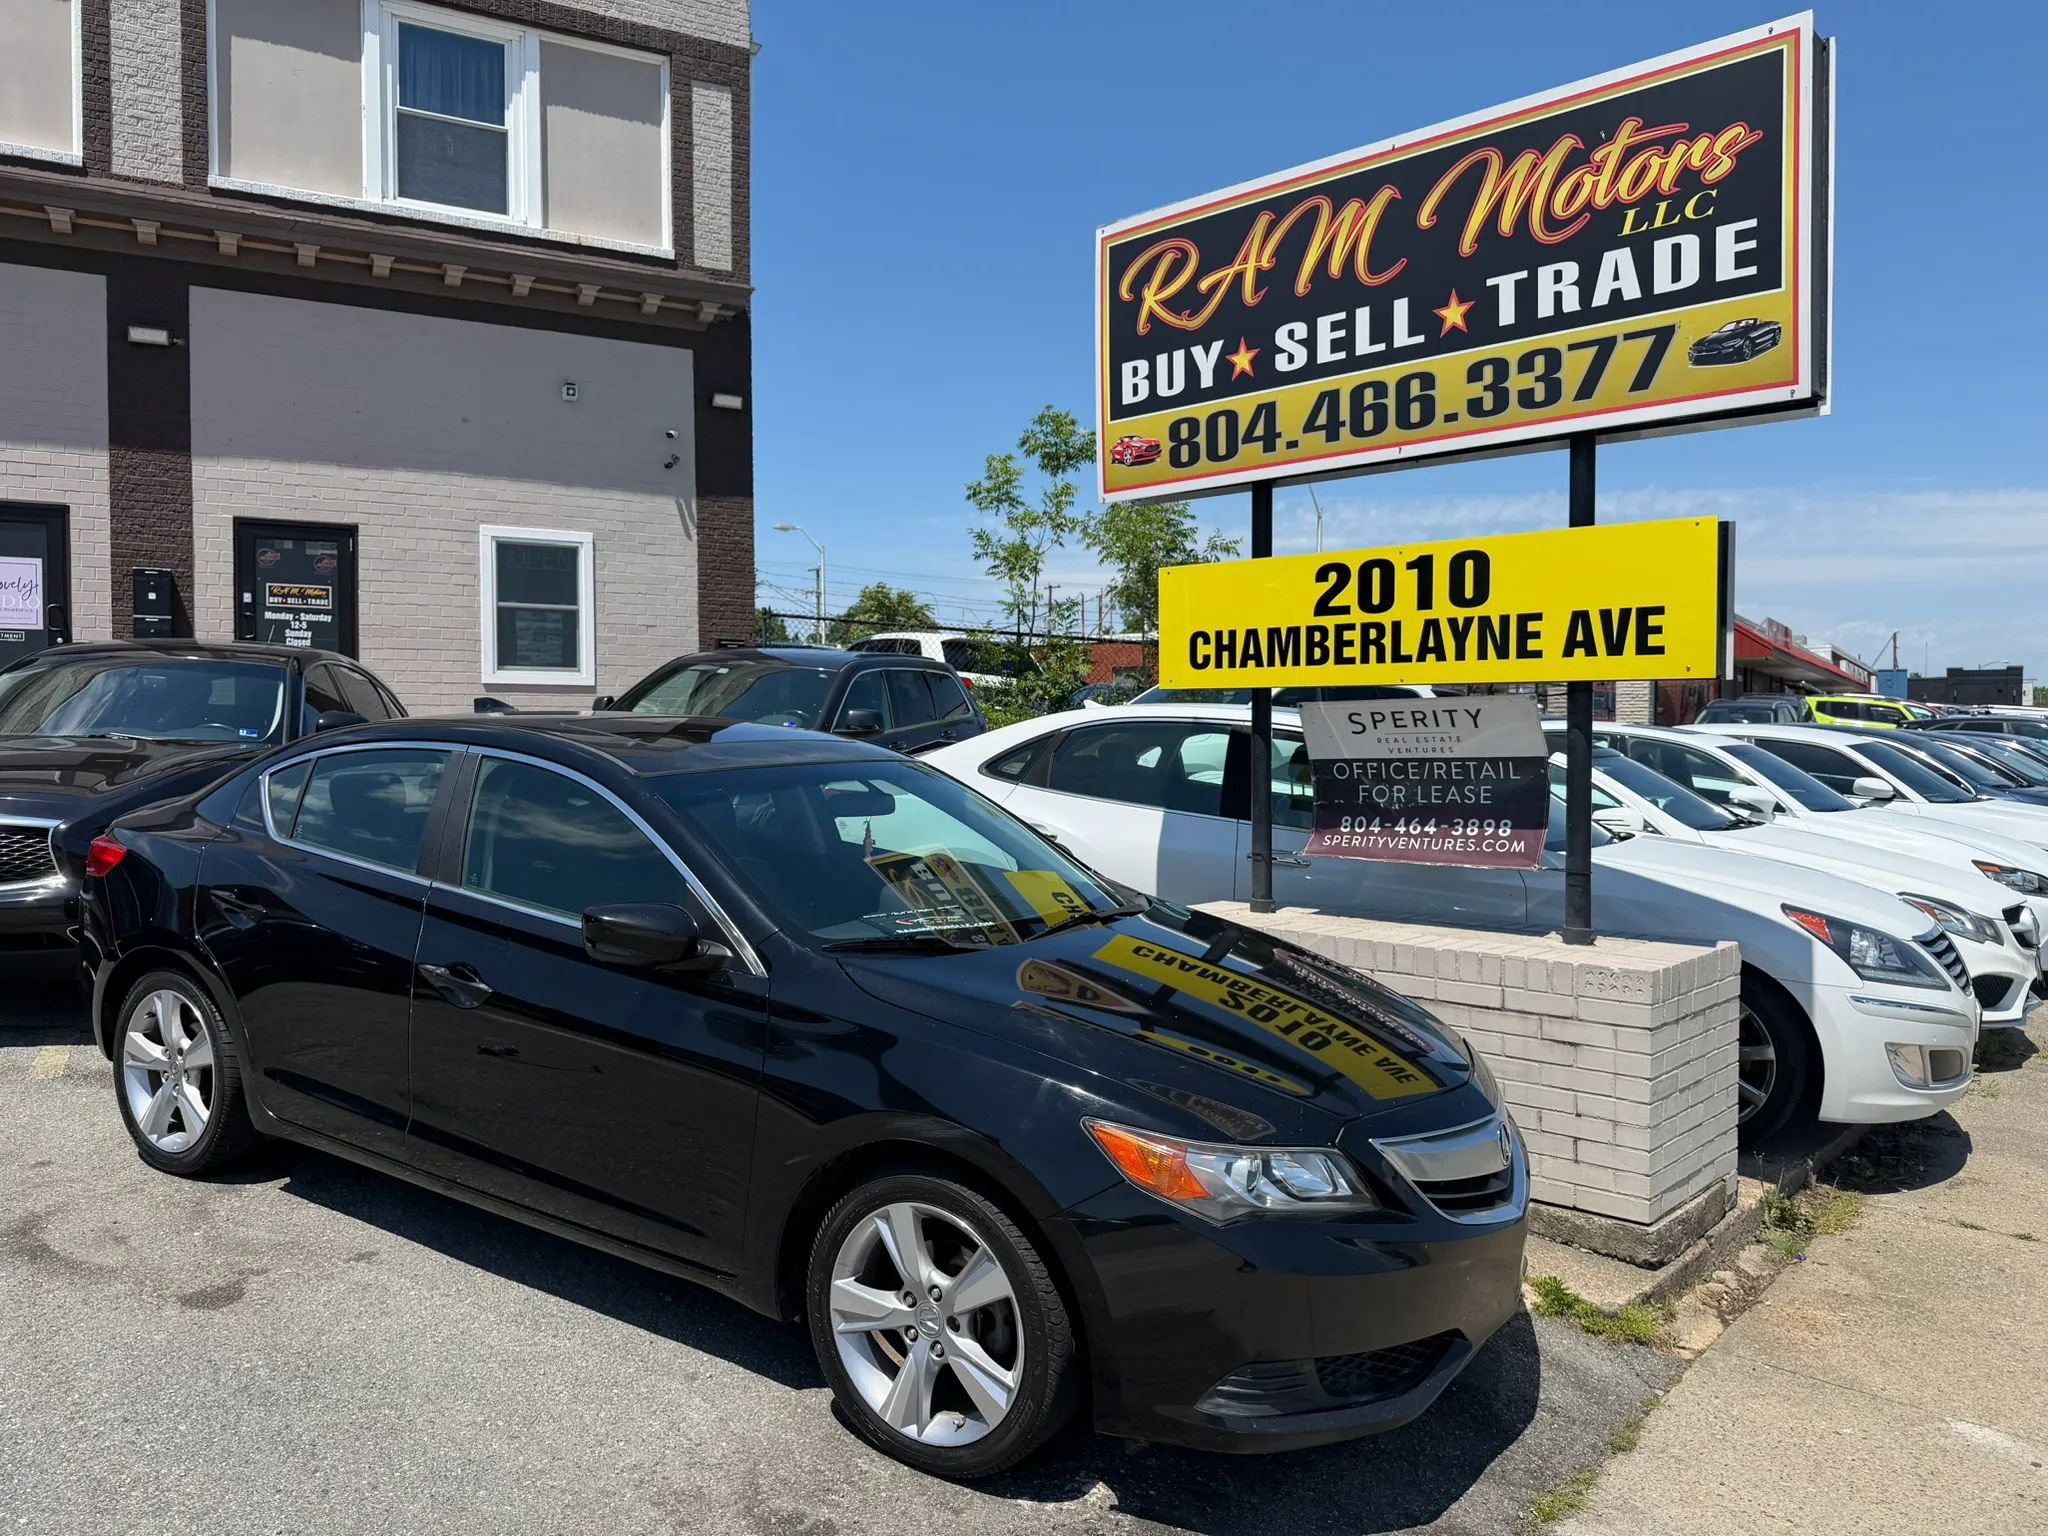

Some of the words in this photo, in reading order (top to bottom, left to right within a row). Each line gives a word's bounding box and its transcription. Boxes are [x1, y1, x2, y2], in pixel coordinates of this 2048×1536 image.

[1617, 189, 1717, 236] LLC
[1119, 184, 1407, 336] RAM
[1417, 117, 1763, 257] Motors
[1121, 340, 1224, 405] BUY
[1274, 297, 1425, 372] SELL
[1486, 218, 1758, 327] TRADE
[1168, 323, 1679, 469] 804.466.3377
[1313, 549, 1491, 617] 2010
[264, 611, 294, 621] Monday
[300, 612, 332, 623] Saturday
[291, 621, 307, 629] 12-5
[285, 629, 312, 638] Sunday
[286, 637, 311, 647] Closed
[1188, 612, 1543, 670] CHAMBERLAYNE
[1561, 606, 1665, 658] AVE
[1347, 708, 1482, 735] SPERITY
[1415, 735, 1462, 744] ESTATE
[1333, 761, 1521, 780] OFFICE/RETAIL
[1358, 784, 1405, 804] FOR
[1417, 784, 1492, 804] LEASE
[1340, 815, 1512, 837] 804-464-3898
[1322, 834, 1525, 853] SPERITYVENTURES.COM
